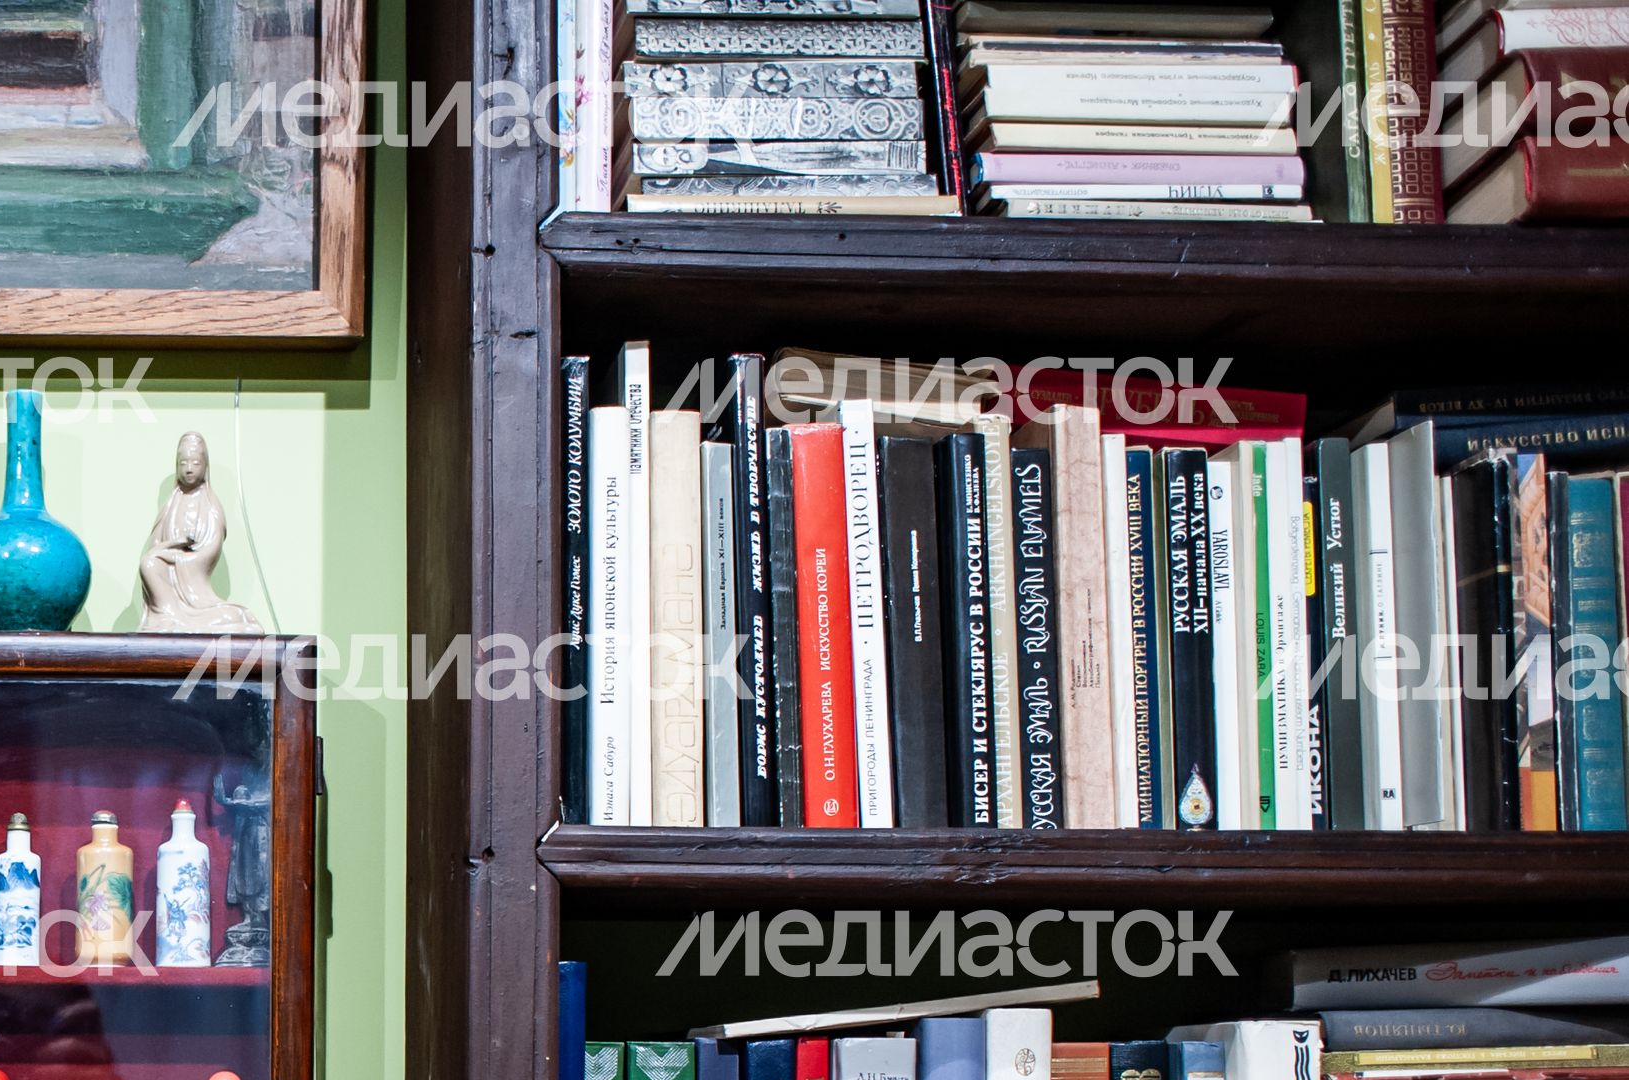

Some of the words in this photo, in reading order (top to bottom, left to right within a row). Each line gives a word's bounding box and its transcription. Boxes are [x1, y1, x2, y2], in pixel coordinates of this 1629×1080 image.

[1384, 27, 1395, 73] ИВАН
[1346, 84, 1357, 97] О
[1344, 108, 1360, 158] САГА
[1168, 185, 1224, 200] УГЛИЧ
[1467, 430, 1579, 452] ИСКУССТВО
[568, 469, 582, 533] ЗОЛОТО
[604, 475, 619, 548] культуры
[1015, 462, 1044, 557] ENAMELS
[1127, 473, 1142, 511] ВЕКА
[1169, 476, 1187, 542] ЭМАЛЬ
[1192, 473, 1205, 500] века
[1251, 473, 1263, 496] Jade
[849, 441, 875, 628] ПЕТРОДВОРЕЦ
[982, 423, 1006, 612] ARKHANGELSKOYE
[1129, 515, 1142, 551] XVIII
[1326, 497, 1342, 549] Устюг
[718, 561, 727, 590] Европа
[815, 547, 828, 591] КОРЕИ
[966, 518, 984, 597] РОССИИ
[1129, 556, 1146, 616] РОССИИ
[1212, 530, 1229, 592] YAROSLAVL
[603, 556, 618, 629] японской
[719, 592, 728, 629] Западная
[969, 603, 985, 615] В
[1019, 567, 1049, 653] RUSSIAN
[1172, 549, 1191, 632] РУССКАЯ
[1329, 562, 1346, 640] Великий
[817, 594, 831, 670] ИСКУССТВО
[1256, 612, 1265, 644] LOUIS
[600, 636, 618, 703] История
[969, 622, 988, 732] СТЕКЛЯРУС
[1133, 631, 1149, 695] ПОРТРЕТ
[1257, 649, 1266, 677] ZARA
[602, 736, 616, 775] Сабуро
[972, 738, 987, 751] И
[1136, 699, 1153, 822] МИНИАТЮРНЫЙ
[1307, 703, 1323, 815] ИКОНА
[866, 742, 879, 816] ПРИГОРОДЫ
[973, 758, 990, 823] БИСЕР
[1030, 753, 1057, 829] УССКАЯ
[1353, 1022, 1441, 1037] ТЫНЯНОВ
